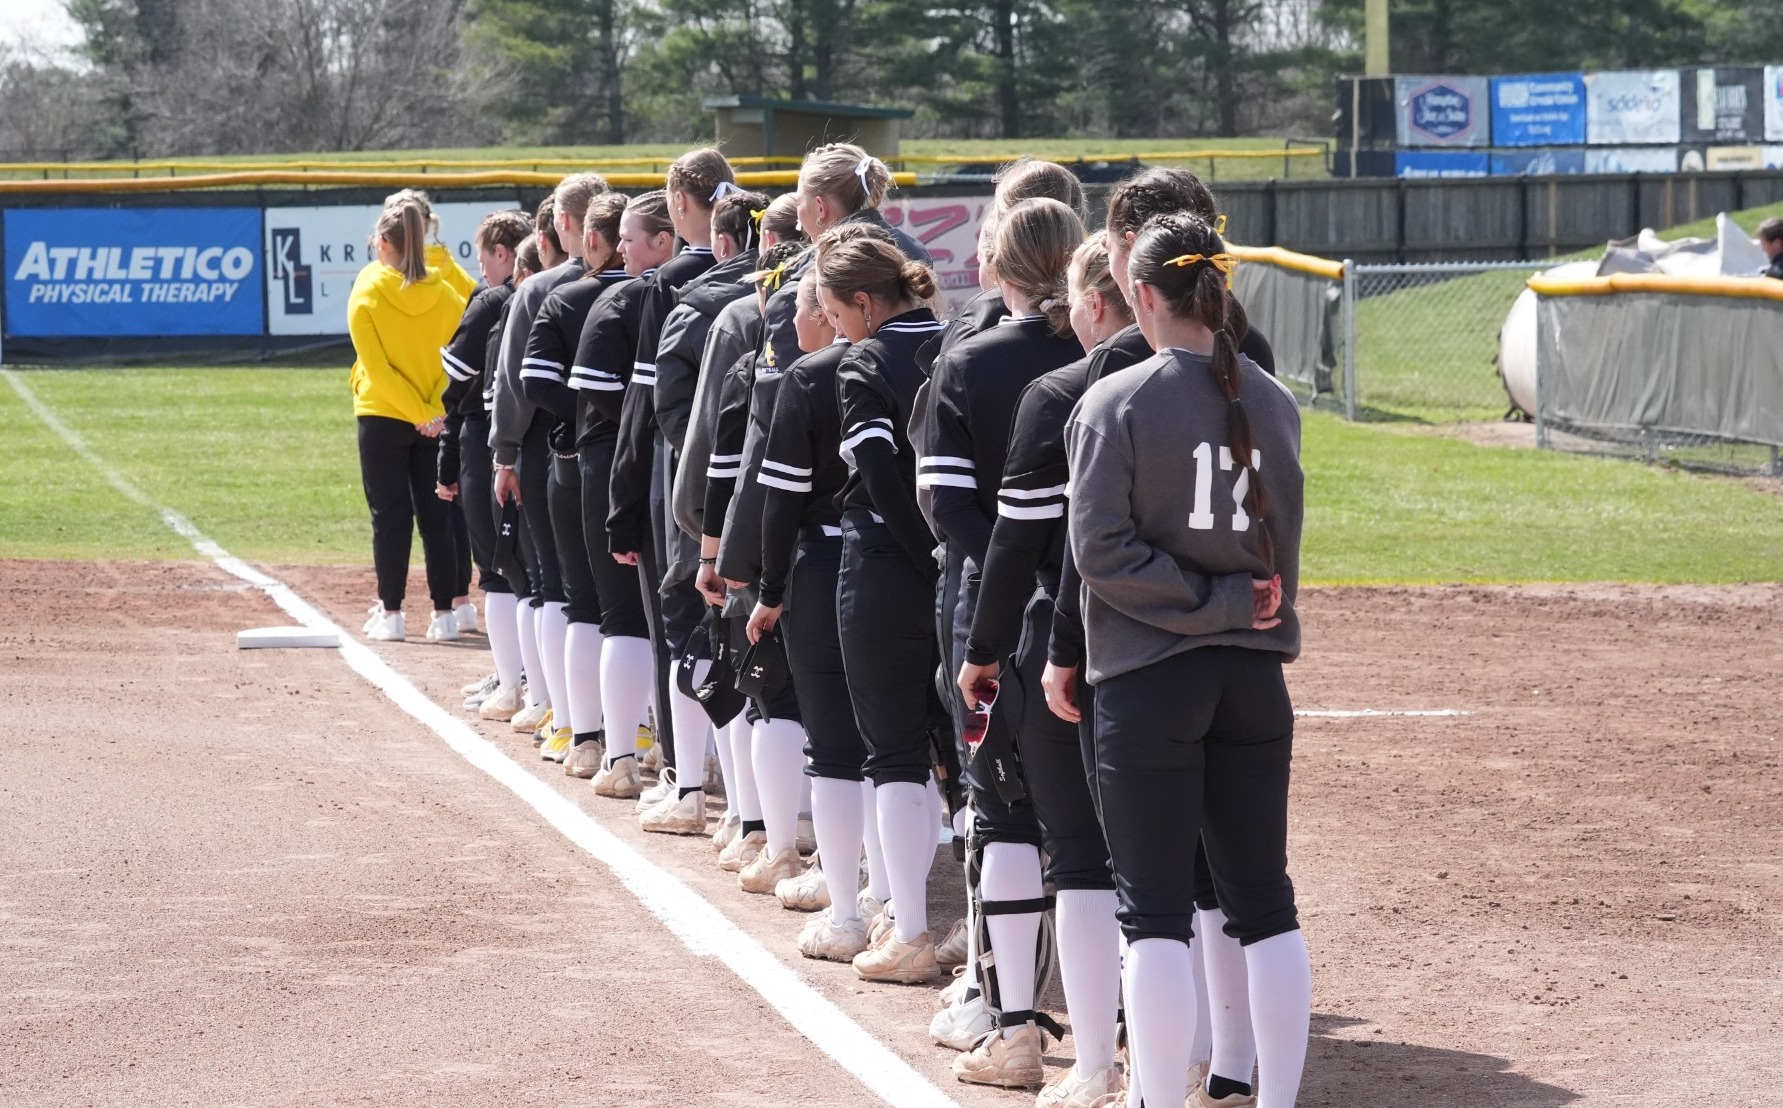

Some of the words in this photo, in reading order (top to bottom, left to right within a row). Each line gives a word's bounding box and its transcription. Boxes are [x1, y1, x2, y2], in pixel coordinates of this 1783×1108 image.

[14, 241, 254, 280] ATHLETICO
[29, 283, 133, 303] PHYSICAL
[141, 283, 239, 302] THERAPY
[1188, 442, 1260, 531] 17
